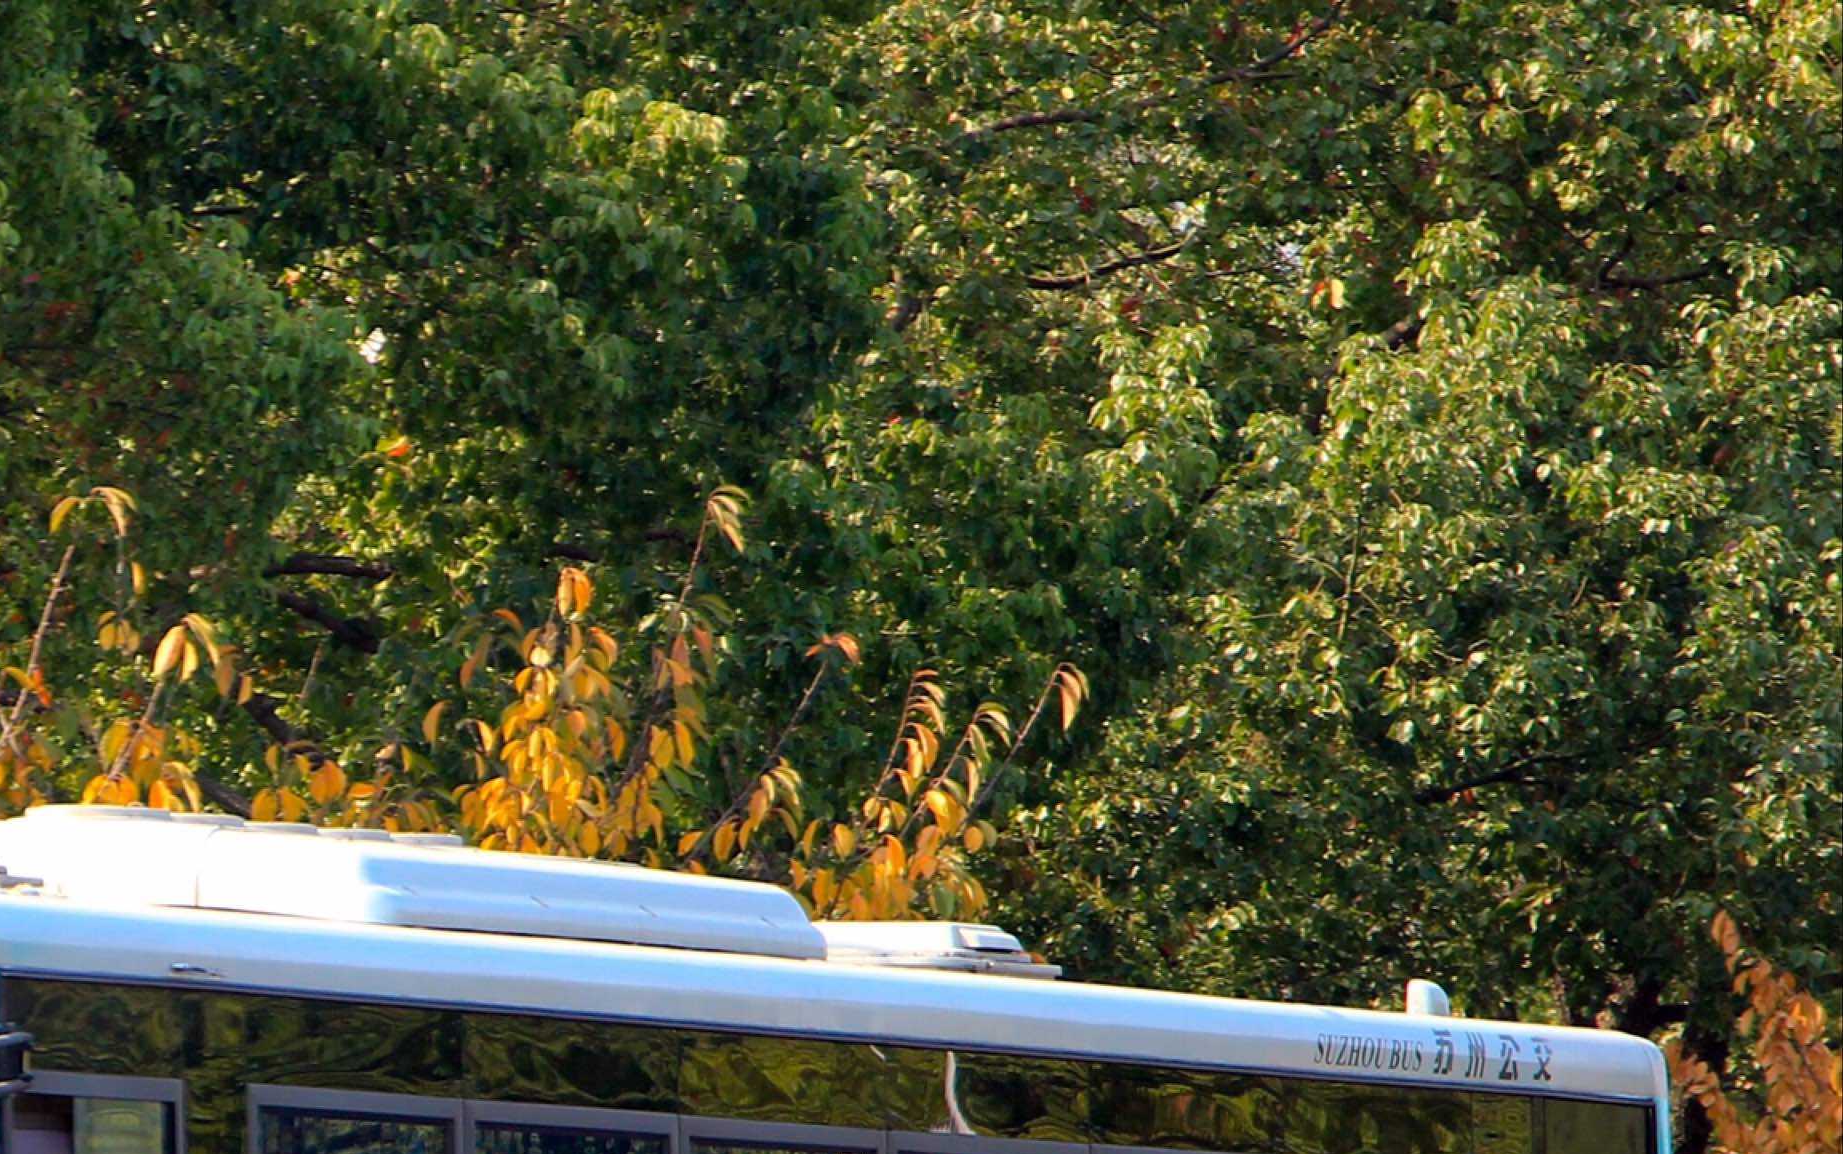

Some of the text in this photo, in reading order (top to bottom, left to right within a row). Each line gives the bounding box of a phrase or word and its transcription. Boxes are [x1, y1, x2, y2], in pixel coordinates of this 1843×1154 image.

[1314, 1031, 1423, 1071] SUZHOU BUS
[1431, 1028, 1553, 1081] 苏州公交
